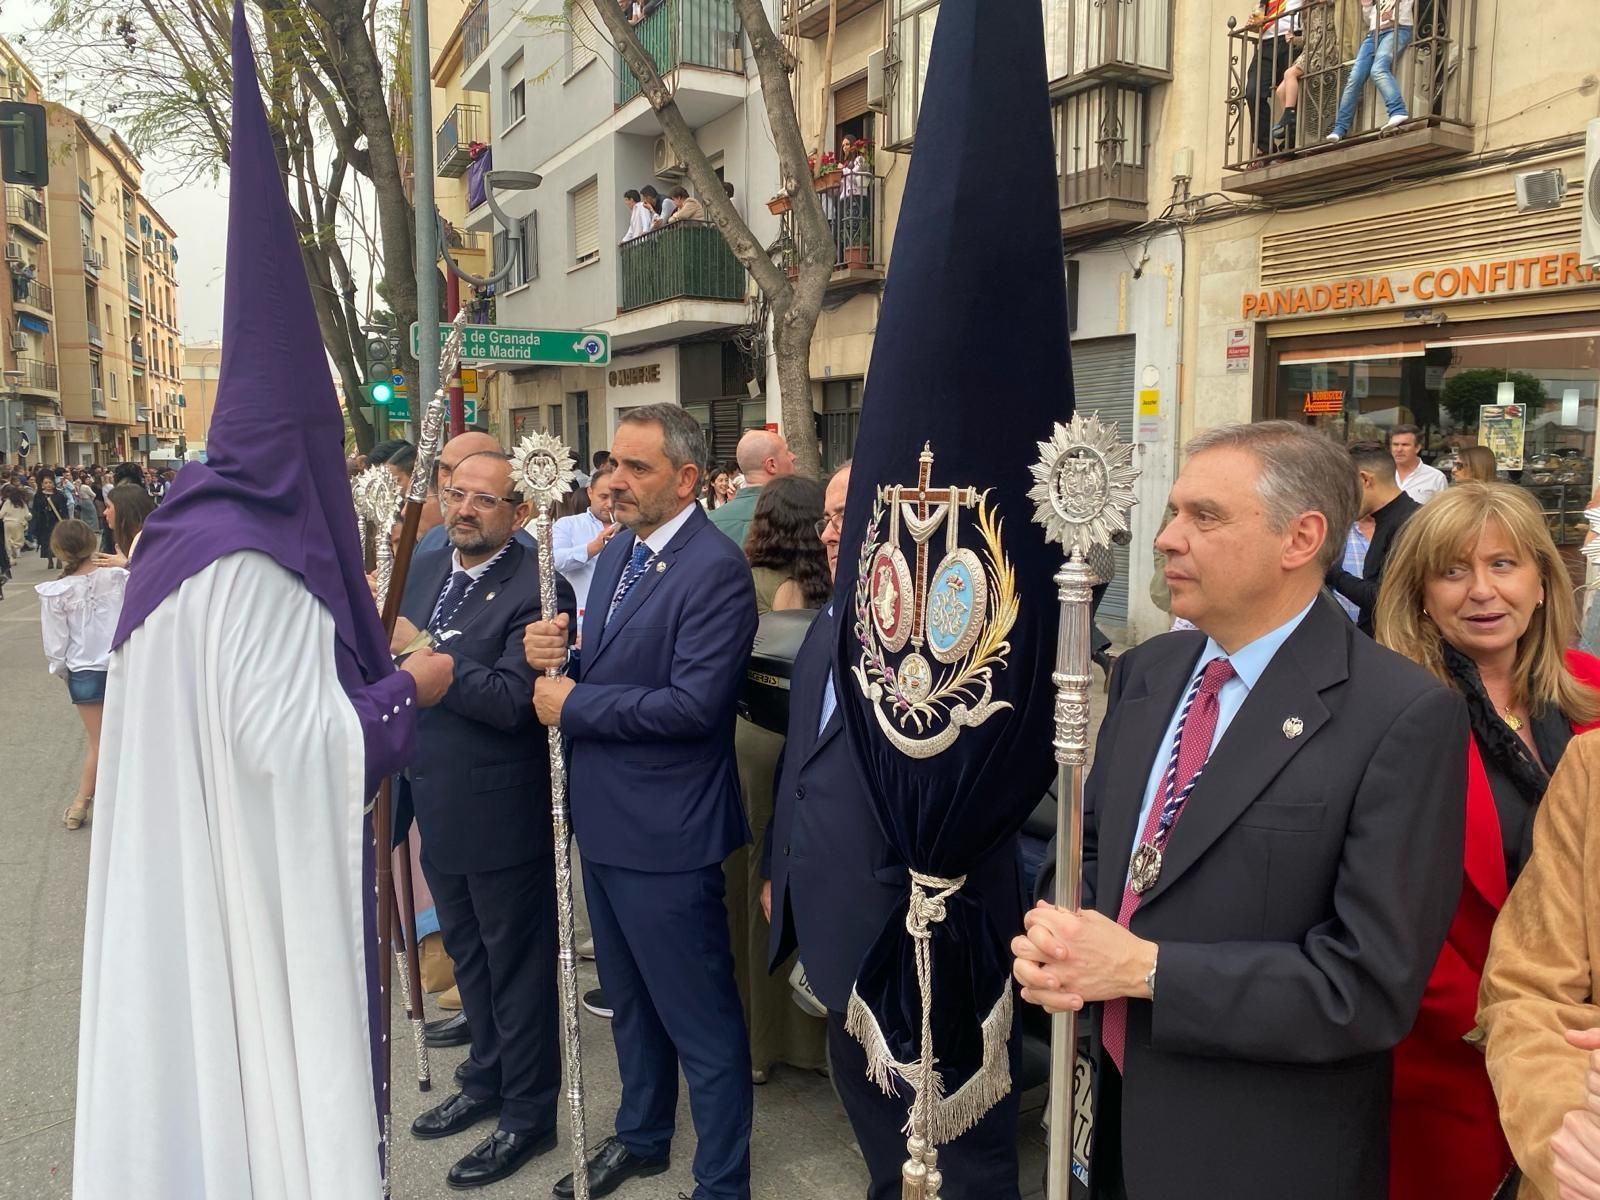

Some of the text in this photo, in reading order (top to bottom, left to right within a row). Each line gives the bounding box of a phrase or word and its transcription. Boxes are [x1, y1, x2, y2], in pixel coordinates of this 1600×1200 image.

[1241, 252, 1600, 319] PANADERIA-CONFITER
[471, 329, 485, 343] de
[489, 331, 541, 346] Granada
[471, 343, 485, 357] de
[489, 346, 531, 359] Madrid
